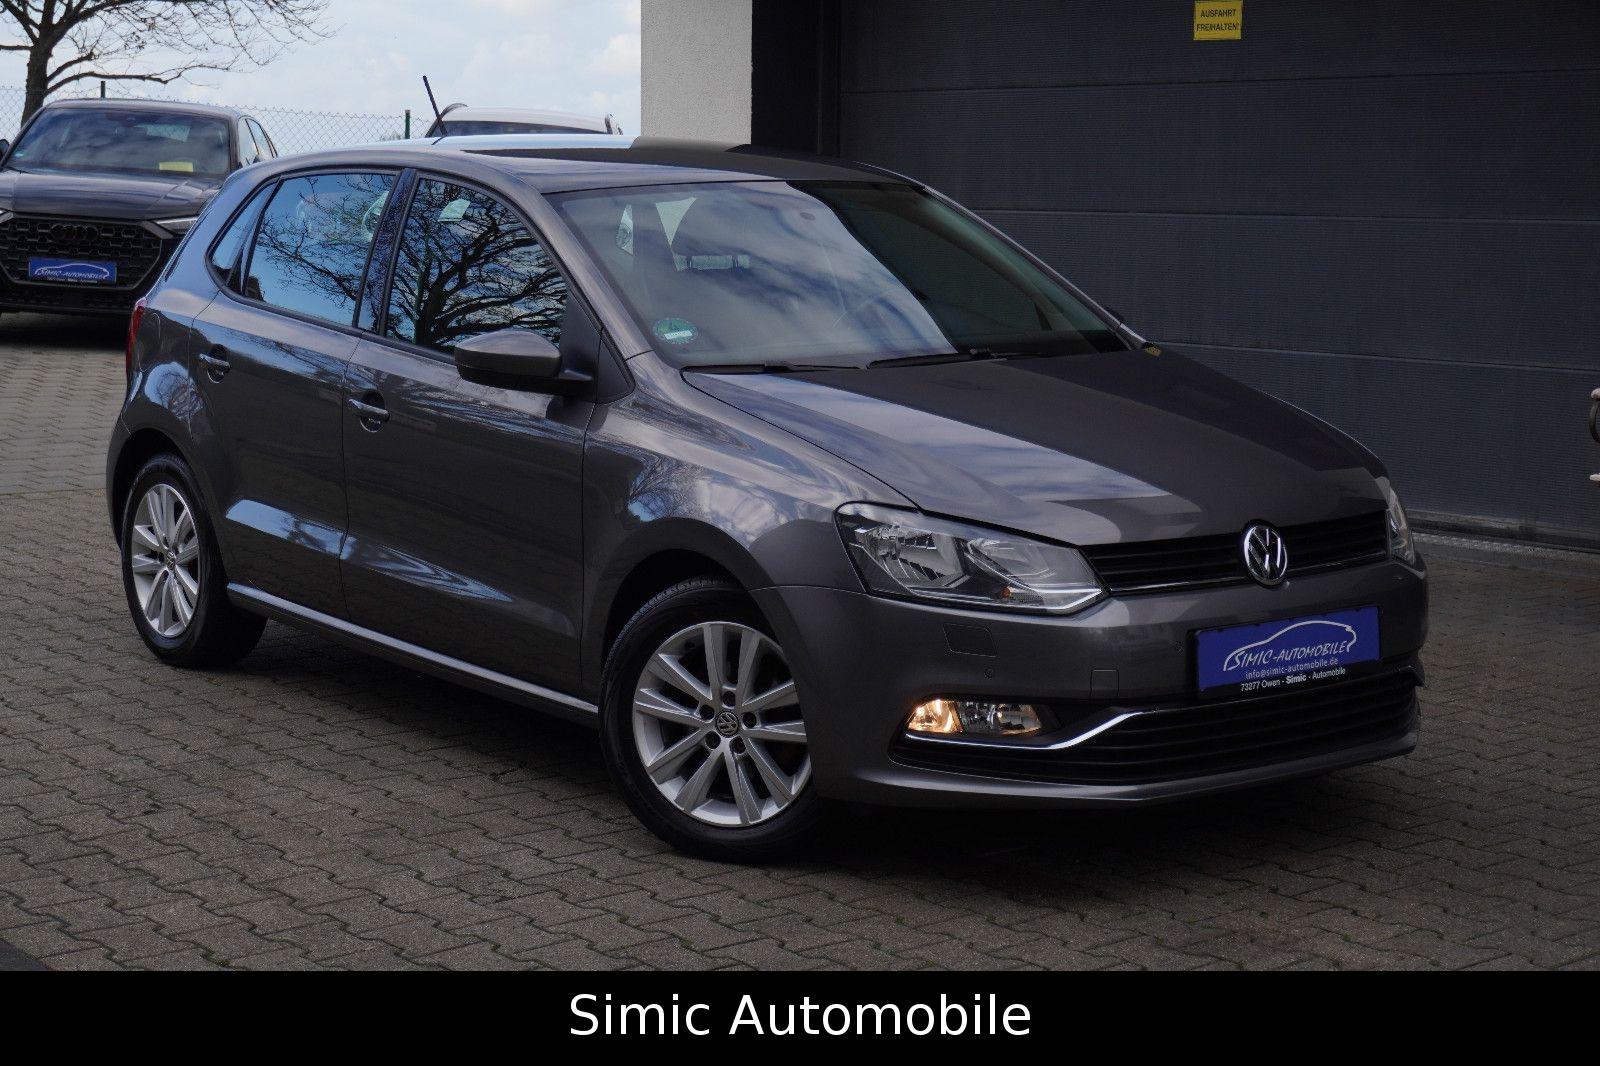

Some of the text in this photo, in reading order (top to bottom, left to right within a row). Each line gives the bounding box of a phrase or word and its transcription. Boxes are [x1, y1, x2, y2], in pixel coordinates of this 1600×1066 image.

[1200, 9, 1236, 17] AUSFAHRT
[1226, 640, 1347, 671] SIMIC-AUTOMOBILE
[1241, 681, 1260, 692] 73277
[1261, 678, 1281, 689] Owen
[1286, 674, 1307, 685] Simic
[1312, 667, 1346, 680] Automobile
[1246, 657, 1338, 680] info@simic-automobile.de
